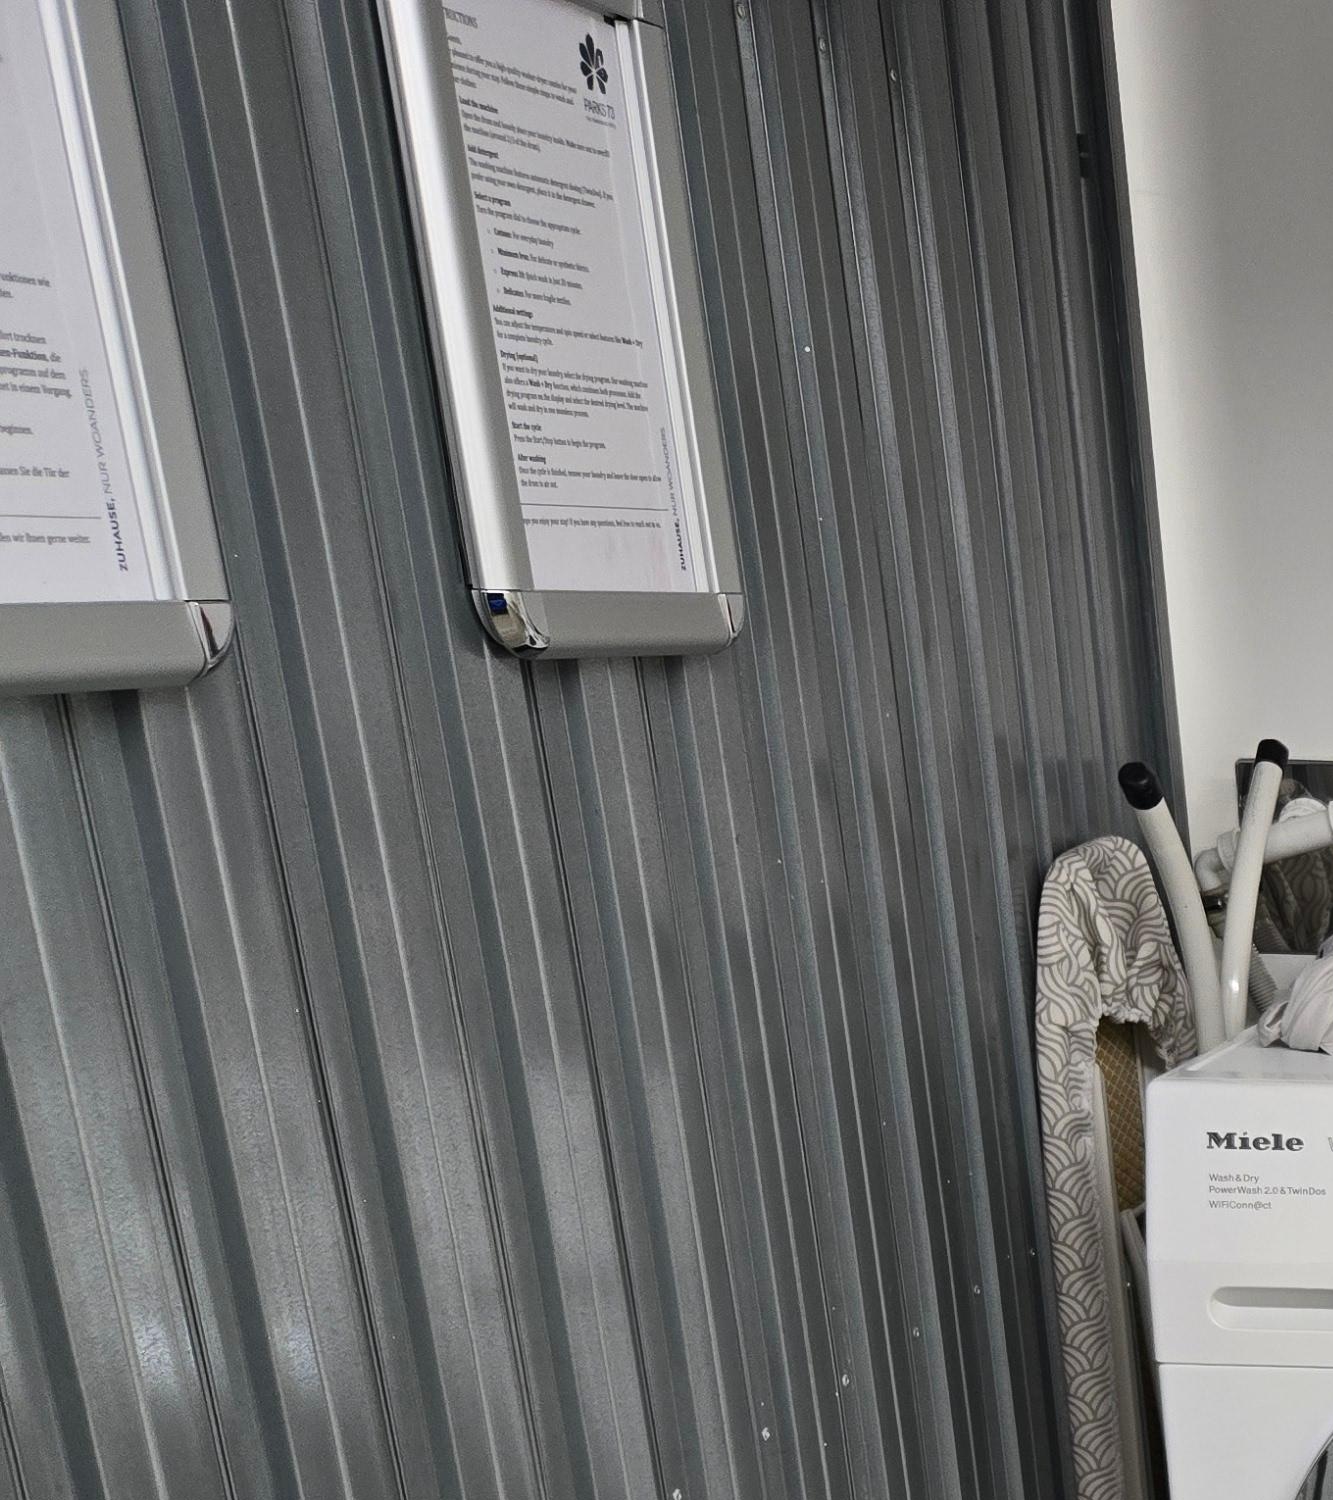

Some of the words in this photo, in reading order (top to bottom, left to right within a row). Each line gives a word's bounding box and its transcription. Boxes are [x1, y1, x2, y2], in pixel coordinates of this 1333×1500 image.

[79, 368, 105, 458] WOANDERS
[660, 426, 674, 490] WOANDERS
[98, 461, 113, 494] NUR
[668, 492, 679, 516] NUR
[106, 497, 128, 572] ZUHAUSE,
[672, 517, 688, 572] ZUHAUSE,
[1206, 1131, 1304, 1151] Miele
[1209, 1185, 1263, 1195] PowerWash
[1264, 1186, 1278, 1195] 2.0
[1287, 1186, 1326, 1196] TwinDos
[1209, 1200, 1272, 1210] WiFiConn@ct
